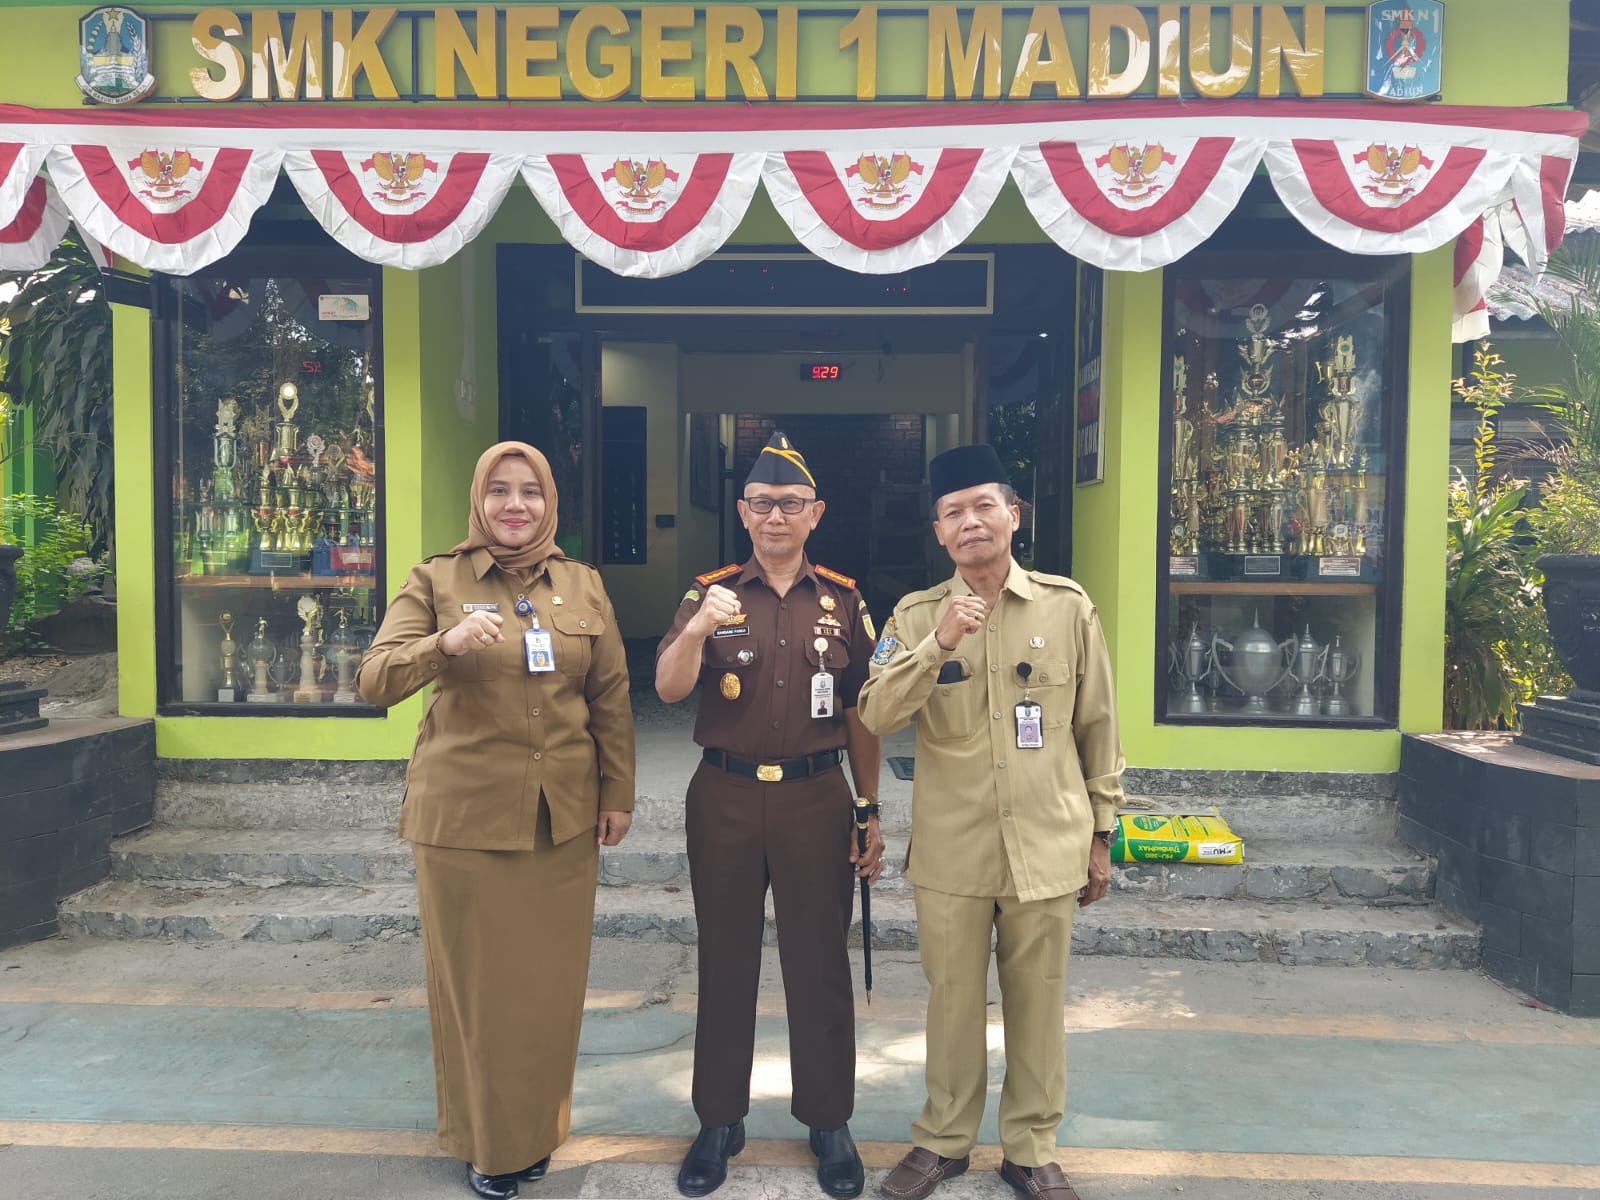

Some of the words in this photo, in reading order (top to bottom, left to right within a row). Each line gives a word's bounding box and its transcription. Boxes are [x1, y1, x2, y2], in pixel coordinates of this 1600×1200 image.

[1381, 9, 1414, 21] SMK
[1417, 9, 1429, 21] N
[1432, 8, 1439, 33] 1
[188, 6, 399, 99] SMK
[433, 4, 798, 101] NEGERI
[839, 6, 878, 100] 1
[927, 3, 1324, 100] MADIUN
